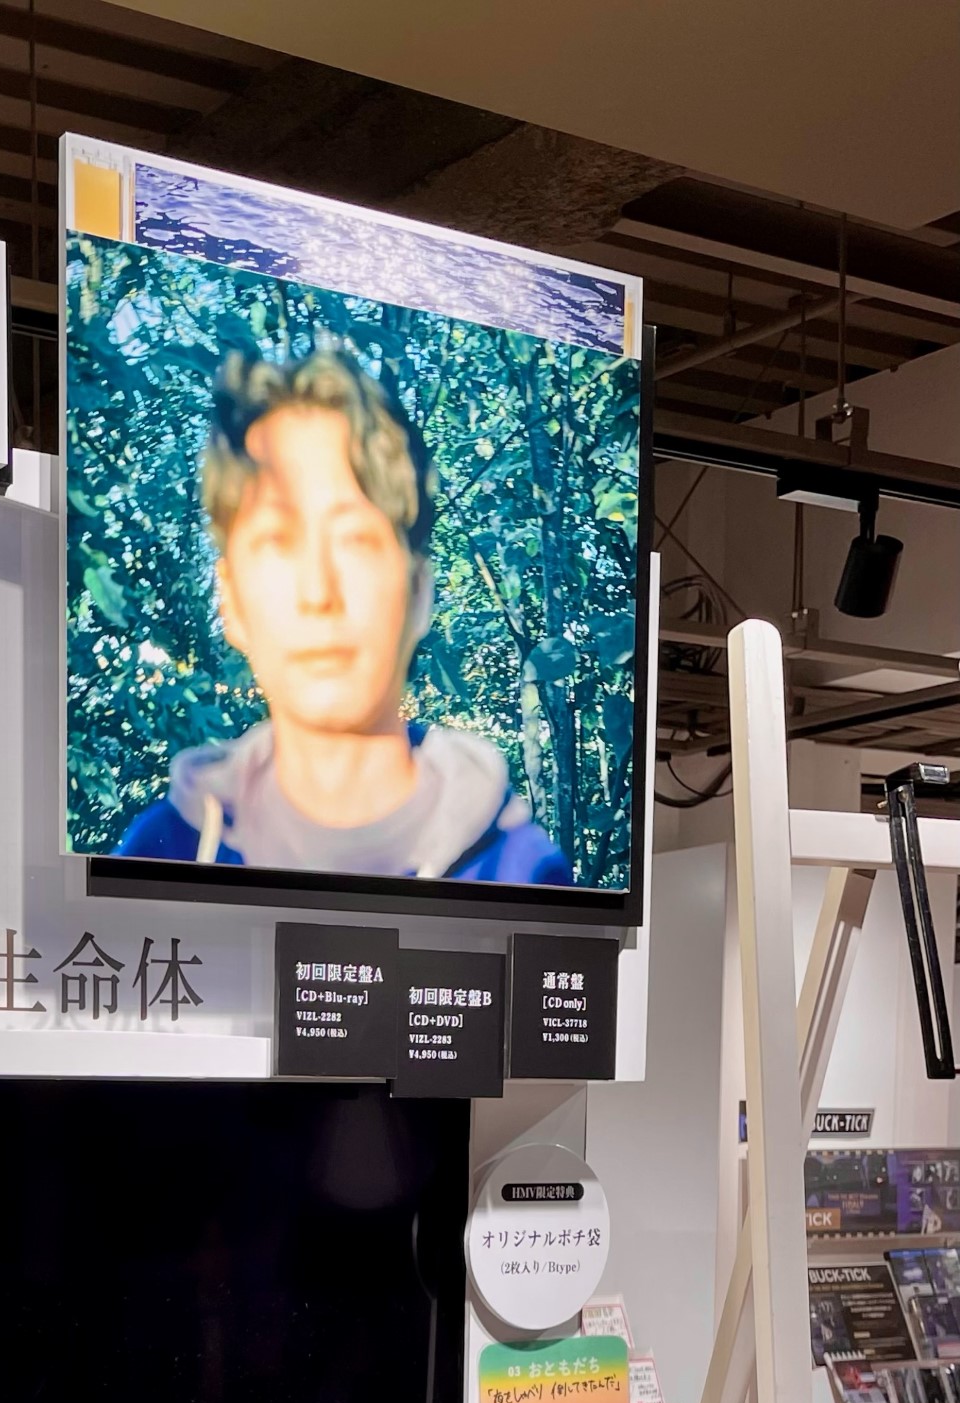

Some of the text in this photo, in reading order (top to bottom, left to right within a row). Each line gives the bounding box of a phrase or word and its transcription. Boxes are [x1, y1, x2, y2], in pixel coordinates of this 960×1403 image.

[295, 961, 384, 984] 初回限定盤A
[542, 971, 585, 991] 通常盤
[295, 987, 369, 1006] [CD+Blu-ray]
[408, 987, 493, 1008] 初回限定盤B
[296, 1010, 342, 1023] VIZL-2282
[408, 1013, 464, 1028] [CD+DVD]
[409, 1033, 452, 1046] VIZL-2283
[511, 1185, 576, 1199] HMV限定特典
[482, 1228, 601, 1249] オリジナルポチ袋
[507, 1356, 600, 1378] 03 おともだち
